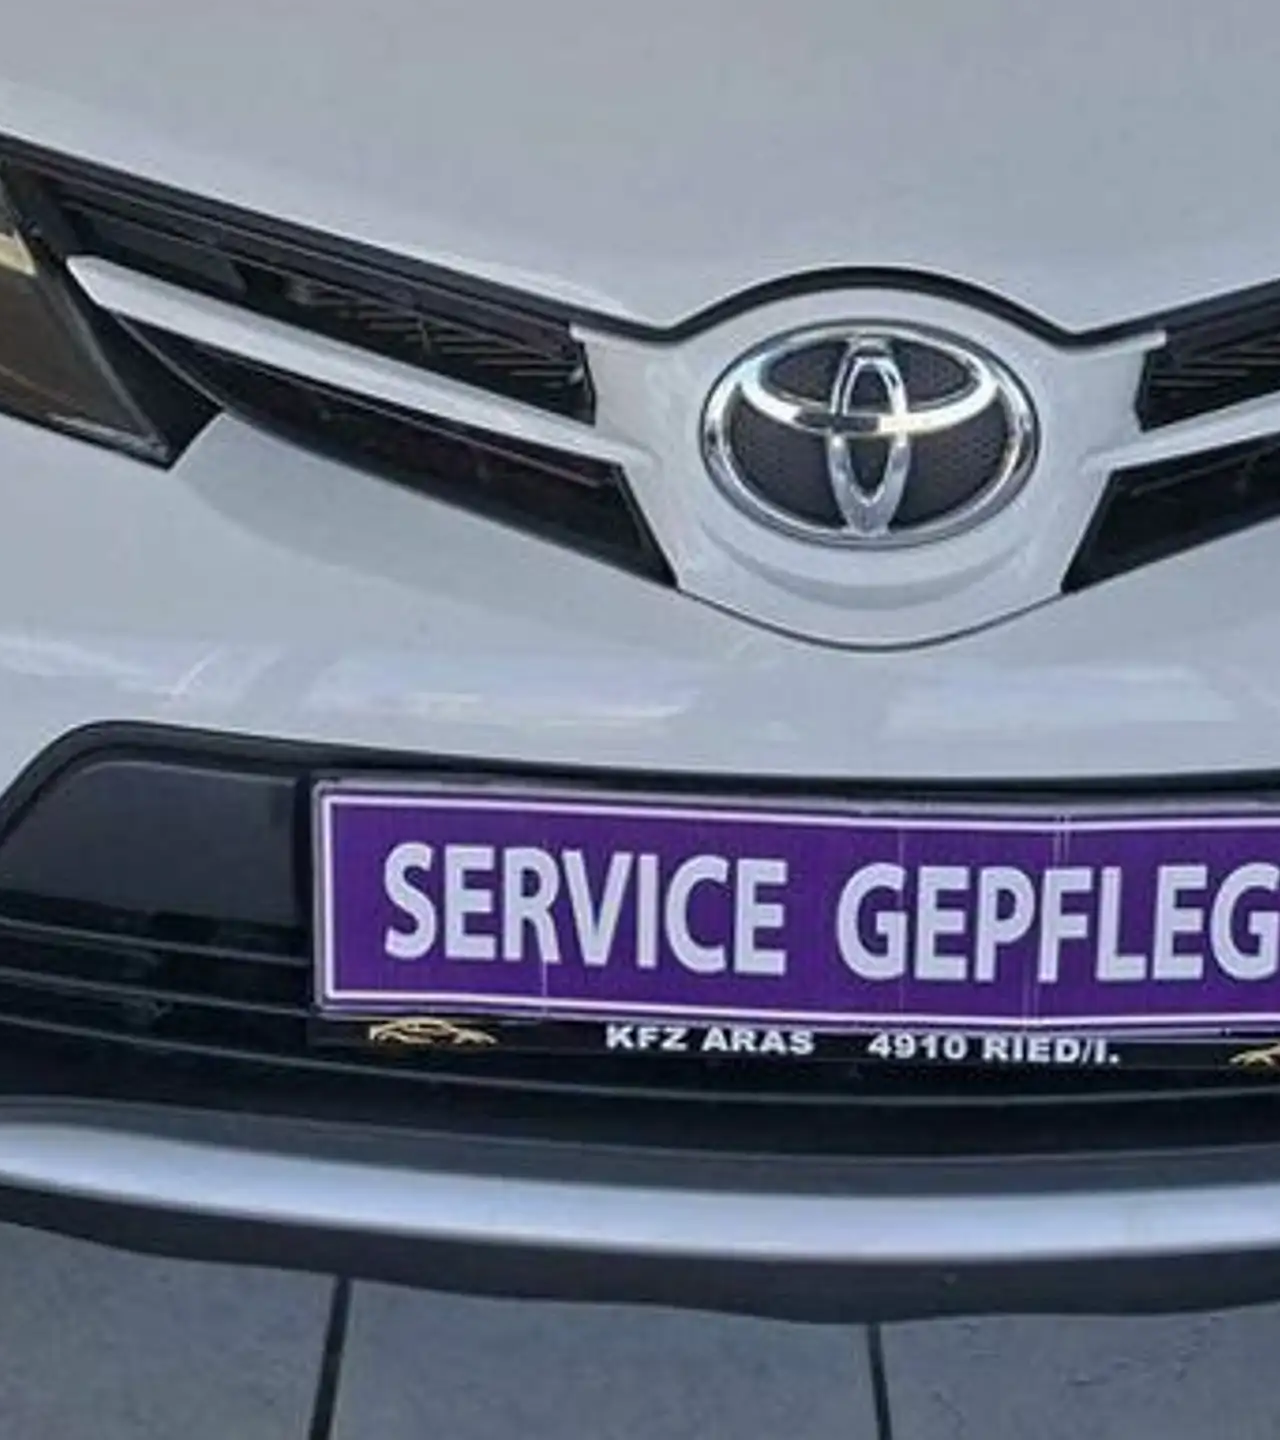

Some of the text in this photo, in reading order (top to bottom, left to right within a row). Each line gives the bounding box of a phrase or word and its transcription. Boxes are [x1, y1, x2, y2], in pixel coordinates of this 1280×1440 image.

[384, 841, 789, 977] SERVICE
[606, 1024, 1120, 1064] KFZ ARAS 4910 RIED/I.
